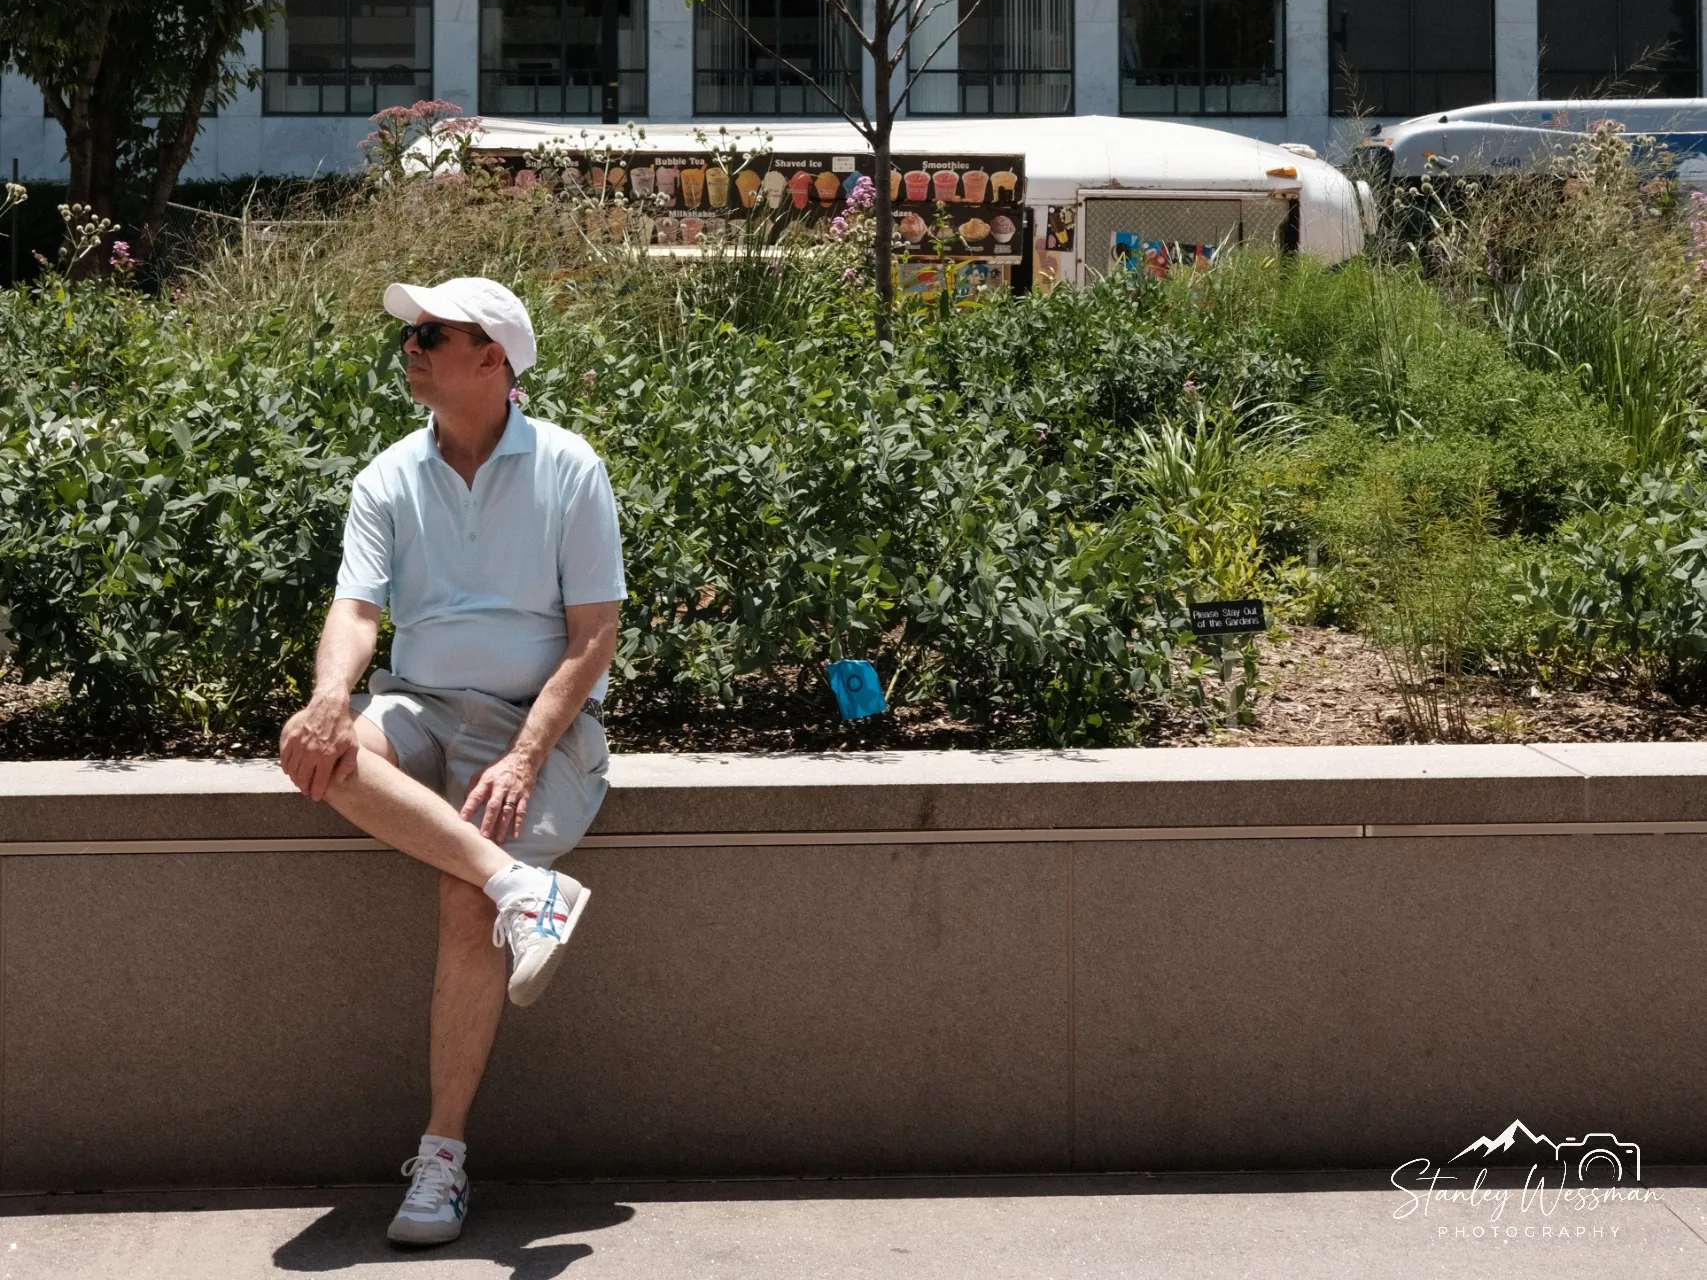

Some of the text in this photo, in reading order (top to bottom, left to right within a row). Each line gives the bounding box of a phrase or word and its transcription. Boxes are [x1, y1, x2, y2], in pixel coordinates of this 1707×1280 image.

[654, 157, 705, 166] Bubble Tea
[774, 160, 822, 168] Shaved Ice
[922, 160, 970, 170] Smoothies
[1192, 607, 1257, 619] Please Stay Out
[1197, 617, 1260, 628] of the Gardens
